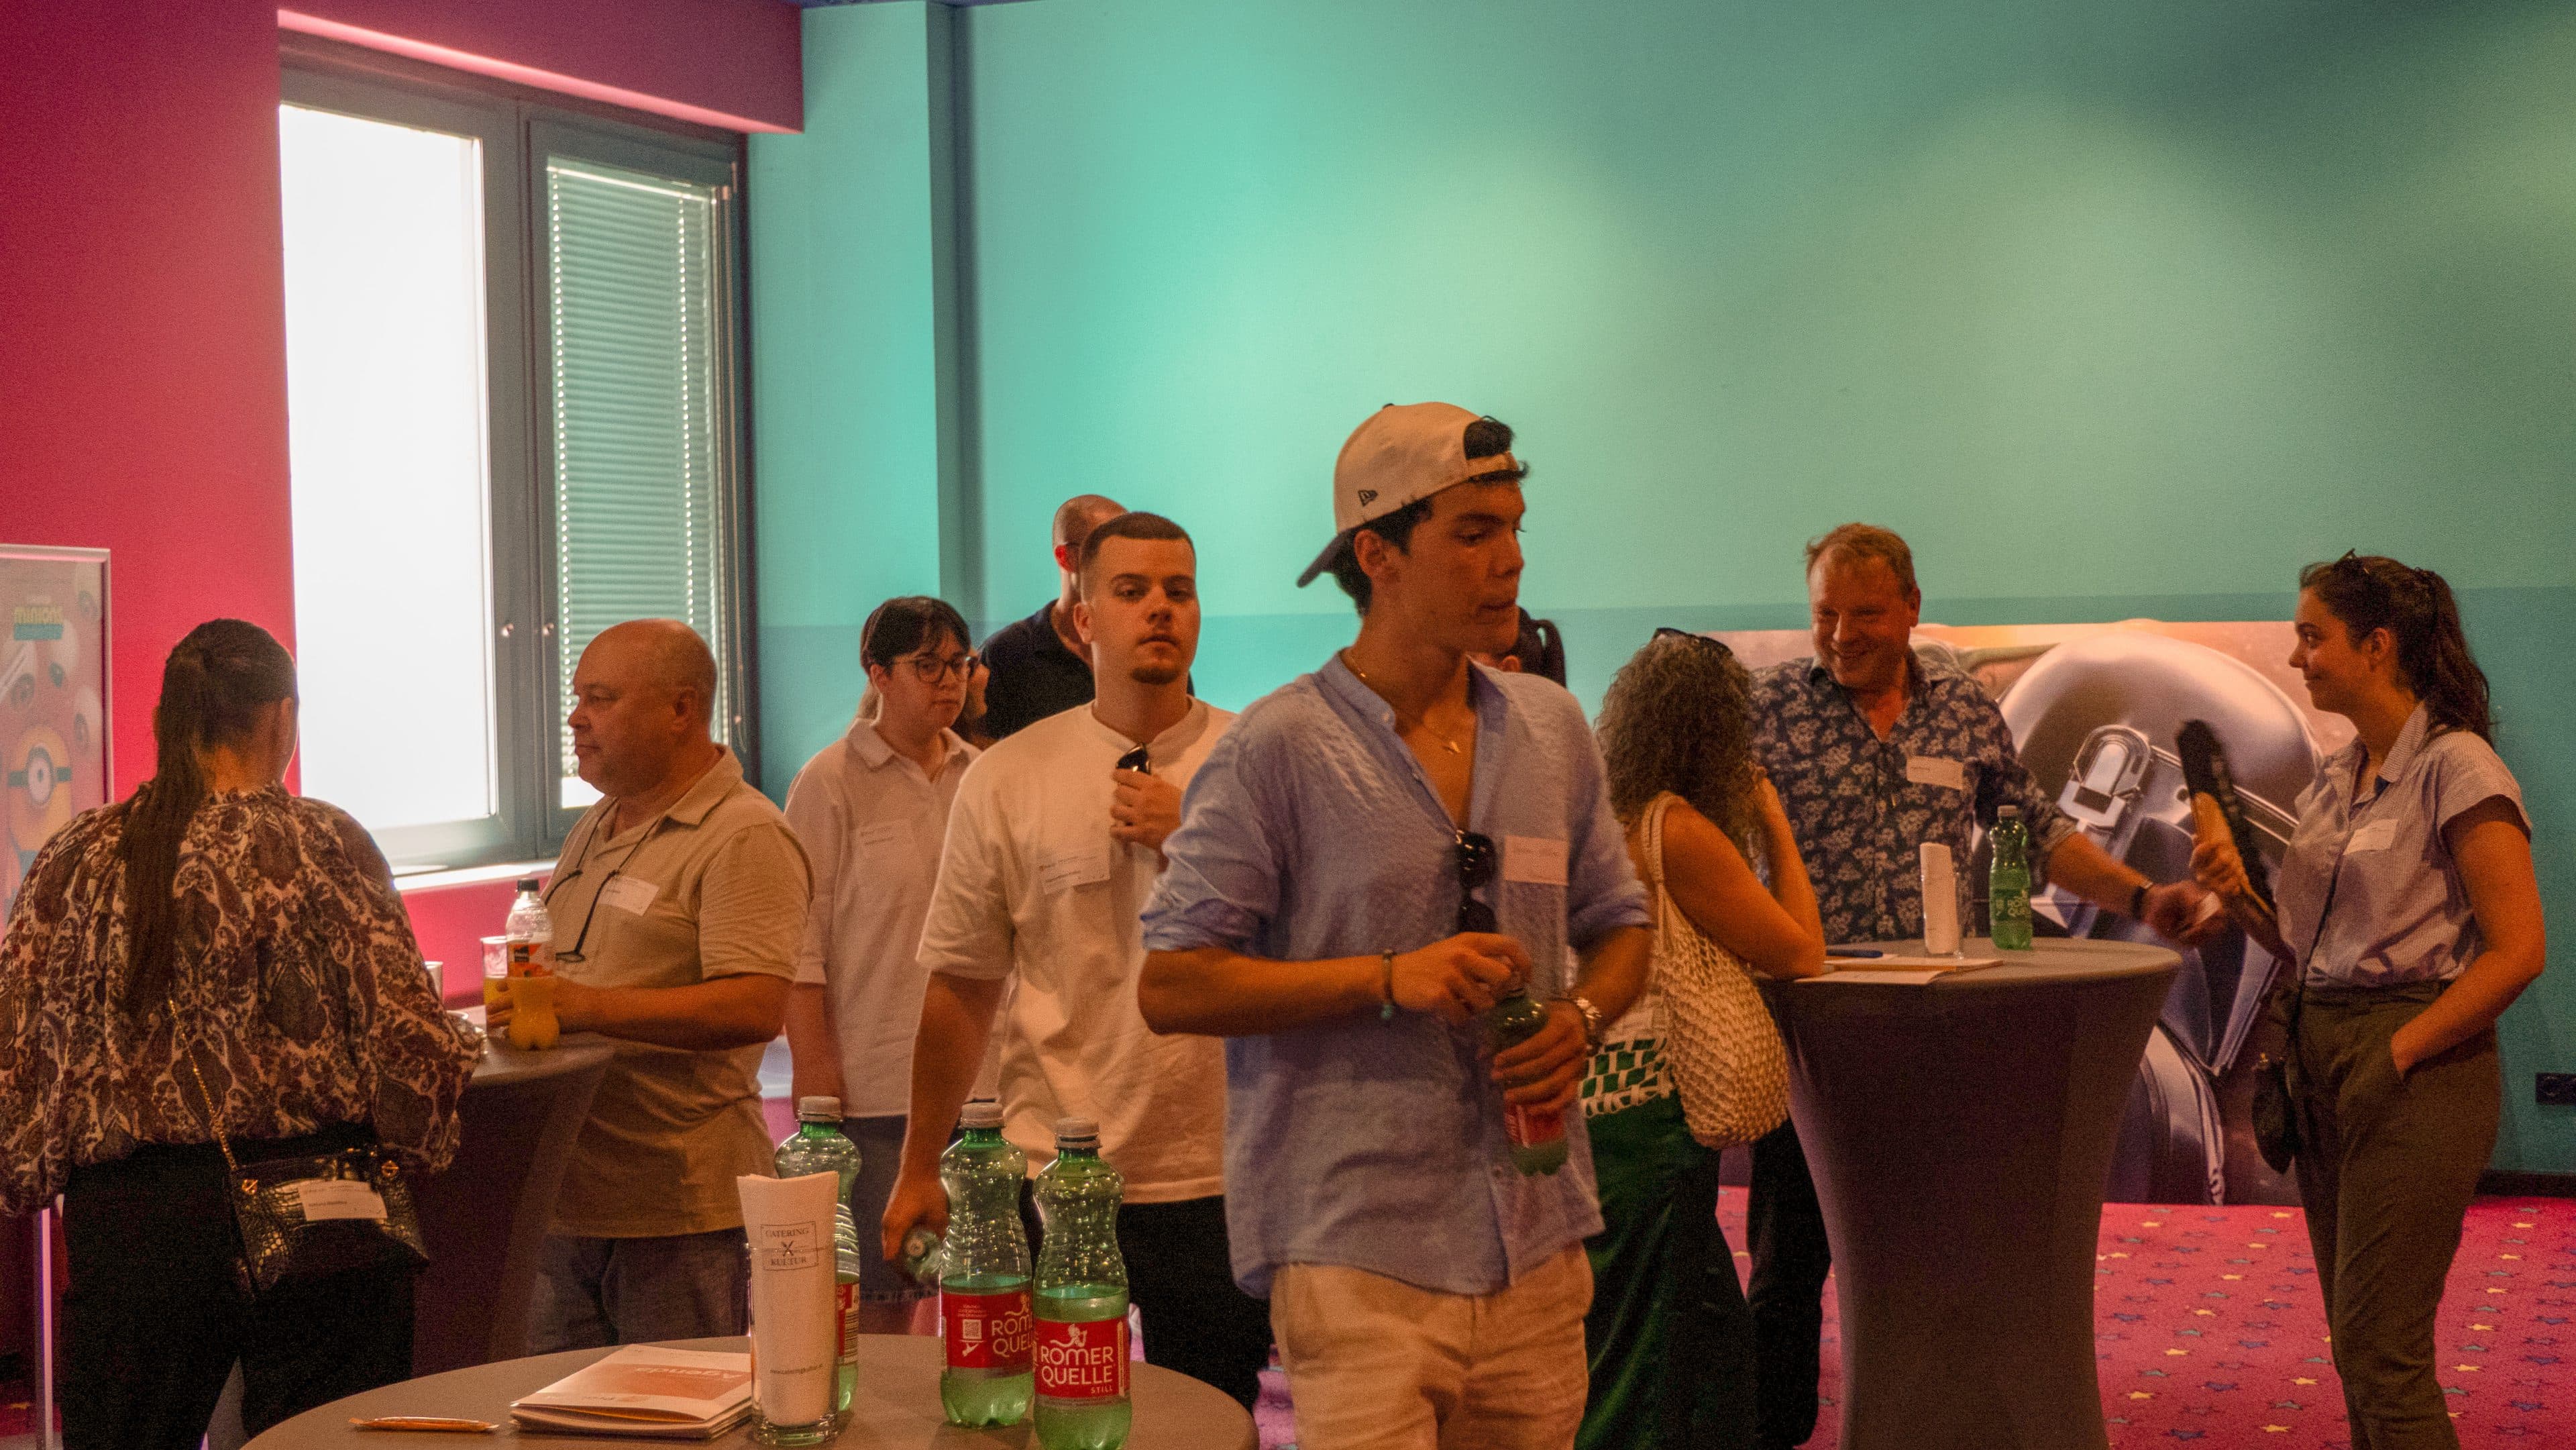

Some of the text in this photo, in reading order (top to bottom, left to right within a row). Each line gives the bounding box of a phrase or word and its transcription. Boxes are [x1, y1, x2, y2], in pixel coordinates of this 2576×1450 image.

[765, 1228, 809, 1237] CATERING
[771, 1256, 806, 1266] KULTUR
[1041, 1365, 1114, 1388] QUELLE
[1090, 1385, 1113, 1394] STILL
